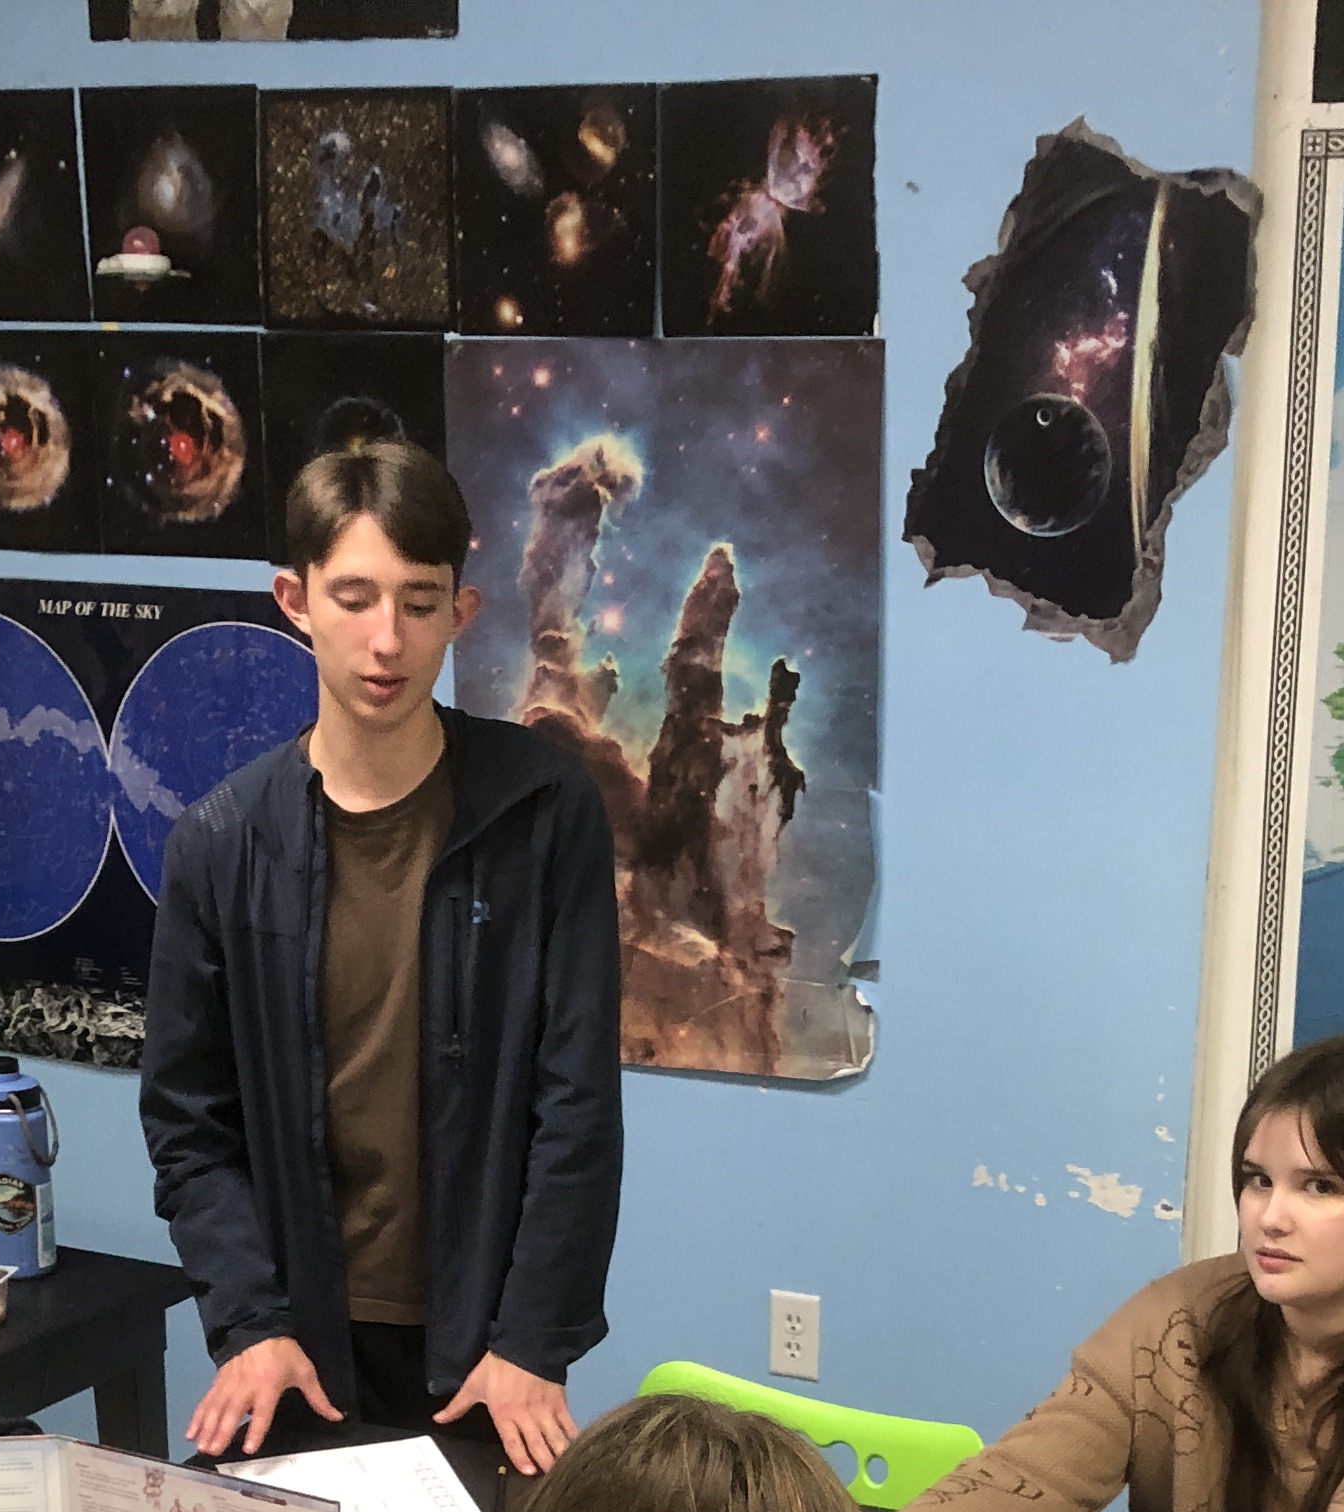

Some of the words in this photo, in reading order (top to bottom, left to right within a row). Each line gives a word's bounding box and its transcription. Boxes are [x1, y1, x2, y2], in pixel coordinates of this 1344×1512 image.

[37, 598, 73, 615] MAP
[74, 600, 97, 617] OF
[100, 601, 132, 618] THE
[134, 603, 165, 621] SKY
